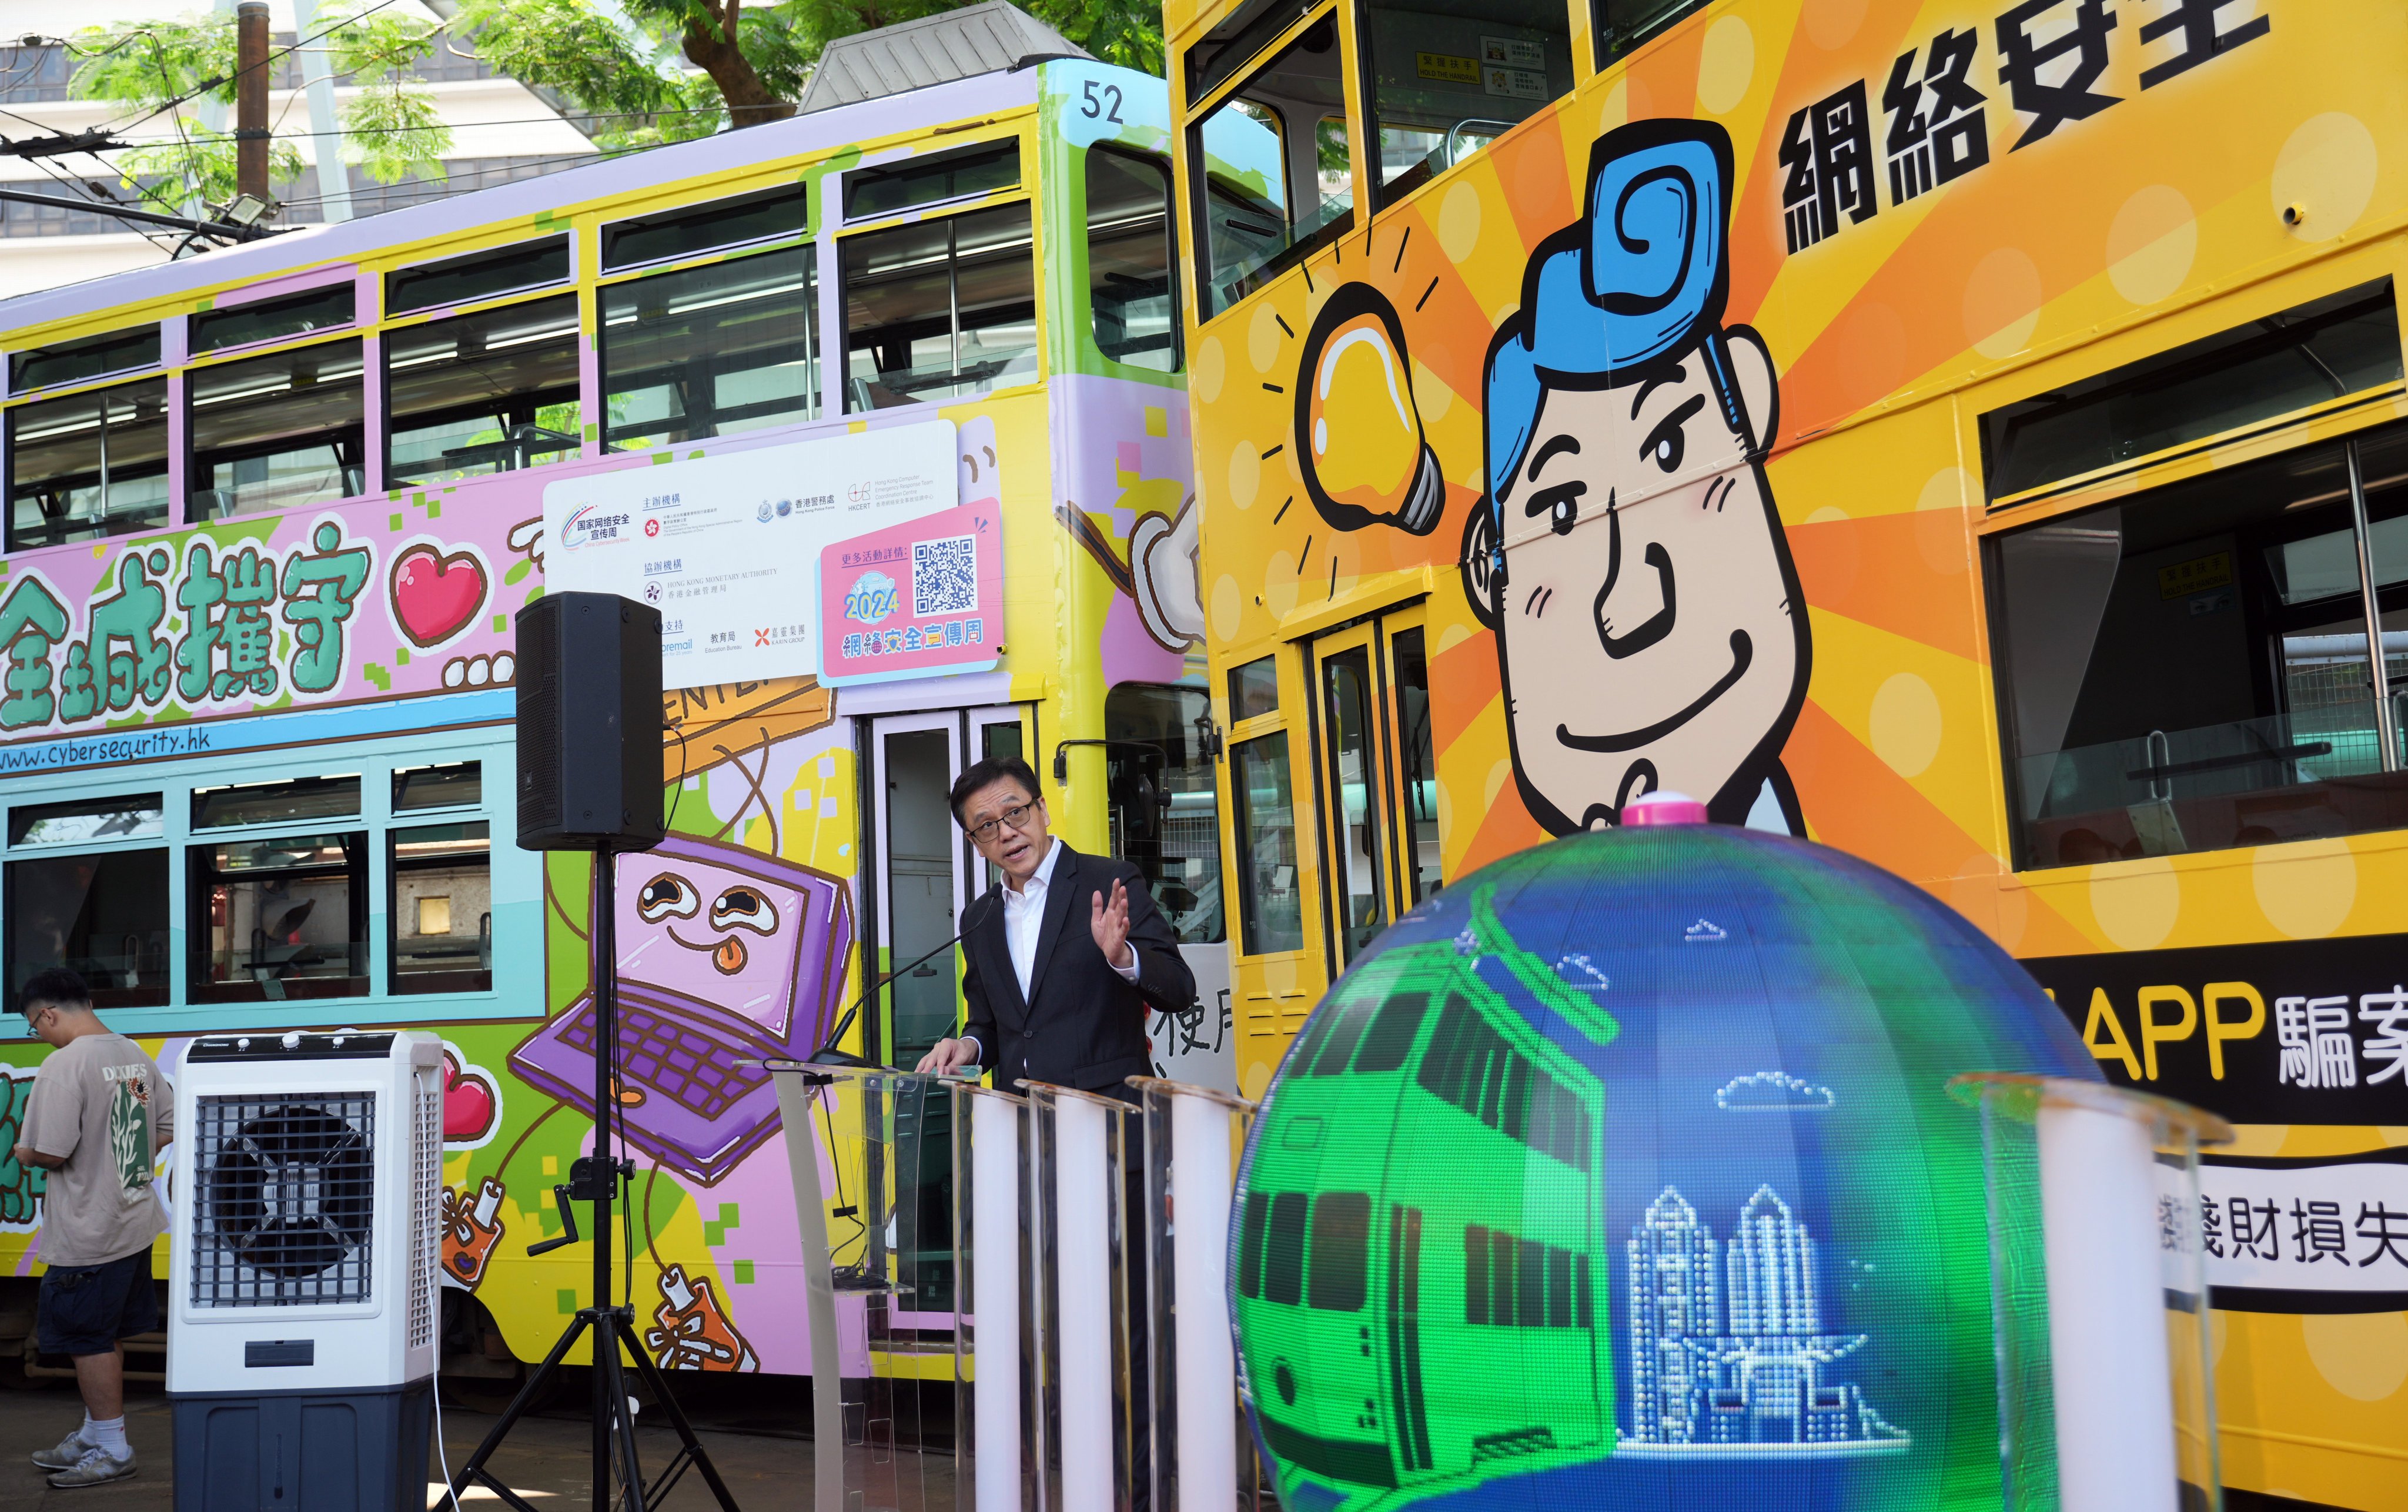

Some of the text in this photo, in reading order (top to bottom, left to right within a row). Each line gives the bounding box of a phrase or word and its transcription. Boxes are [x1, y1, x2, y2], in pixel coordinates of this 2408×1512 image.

[1423, 56, 1471, 70] 緊握扶手
[1449, 72, 1478, 82] HANDRAIL
[1081, 80, 1123, 125] 52
[643, 493, 680, 509] 主辦機構
[795, 494, 834, 509] 香港警務處
[875, 491, 902, 500] Coordination
[848, 503, 871, 511] HKCERT
[577, 514, 630, 531] 国家网络安全
[591, 527, 617, 540] 宣传周
[842, 547, 907, 566] 更多活動詳情：
[644, 558, 682, 574] 協辦機構
[2167, 557, 2221, 581] 緊握扶手
[668, 568, 778, 588] HONG KONG MONETARY AUTHORITY
[2164, 574, 2229, 596] HOLD THE HANDRAIL
[668, 584, 727, 599] 香港金融管理局
[844, 588, 900, 619] 2024
[711, 631, 735, 644] 教育局
[843, 618, 982, 657] 網絡安全宣傳周
[2043, 981, 2408, 1088] APP騙案
[102, 1063, 147, 1082] DIKIES
